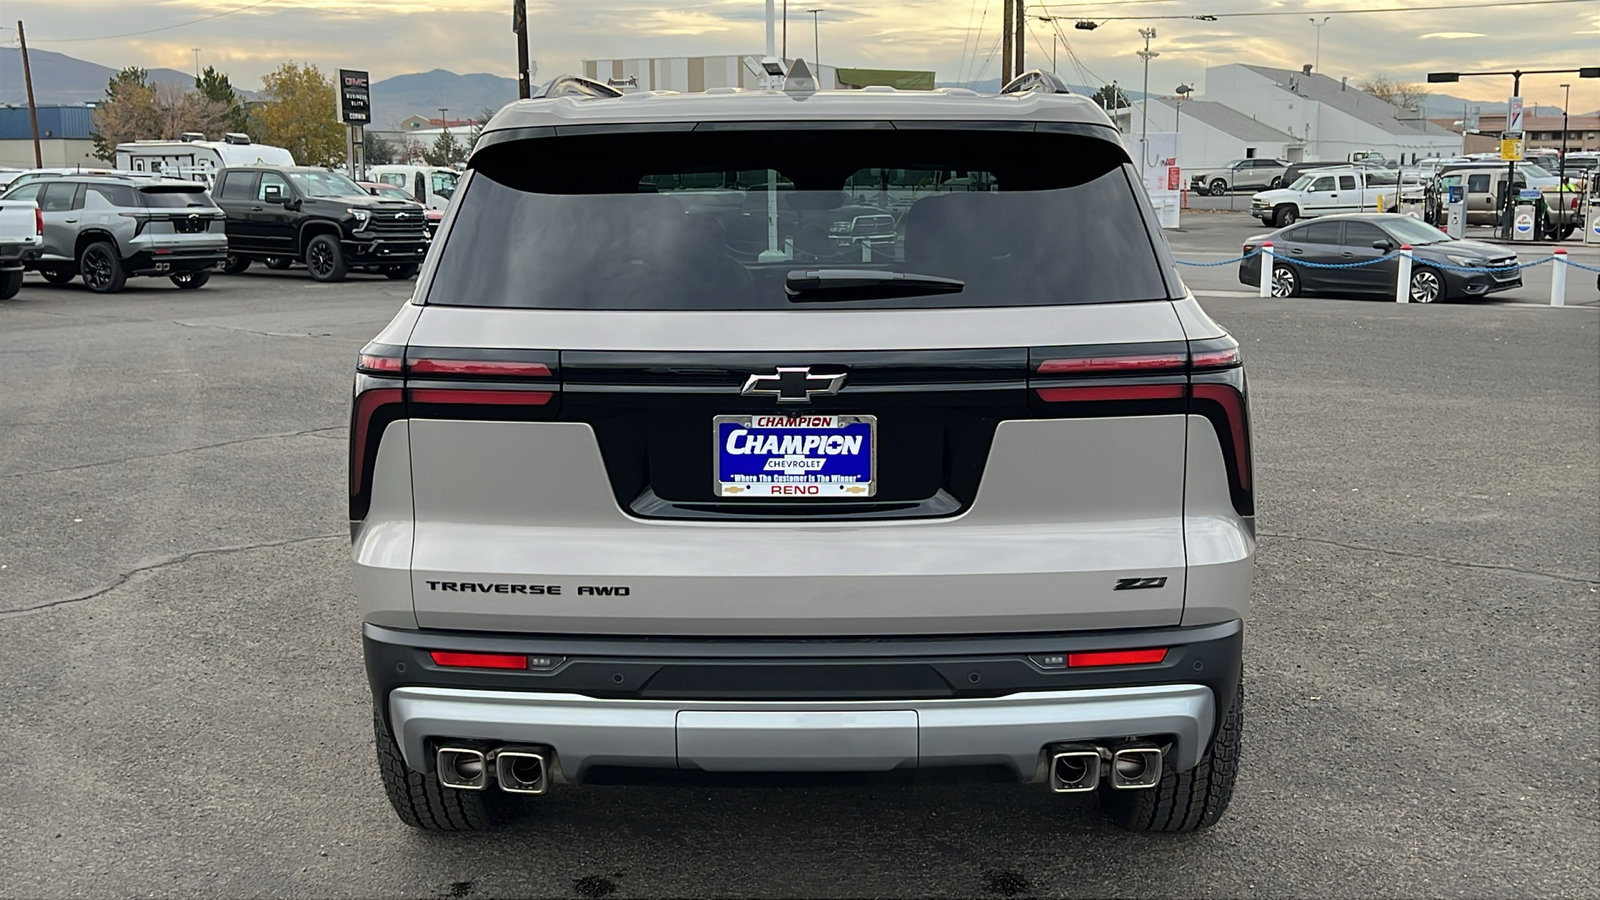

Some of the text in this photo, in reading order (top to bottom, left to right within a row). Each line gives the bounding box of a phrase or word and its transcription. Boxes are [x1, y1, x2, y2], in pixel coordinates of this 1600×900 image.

[344, 77, 367, 87] GMC
[757, 416, 833, 428] CHAMPION
[726, 429, 864, 456] CHAMPION
[767, 460, 822, 469] CHEVROLET
[758, 474, 773, 483] The
[773, 474, 808, 483] Customer
[816, 474, 831, 483] The
[770, 485, 820, 495] RENO
[425, 580, 631, 597] TRAVERSE AWD
